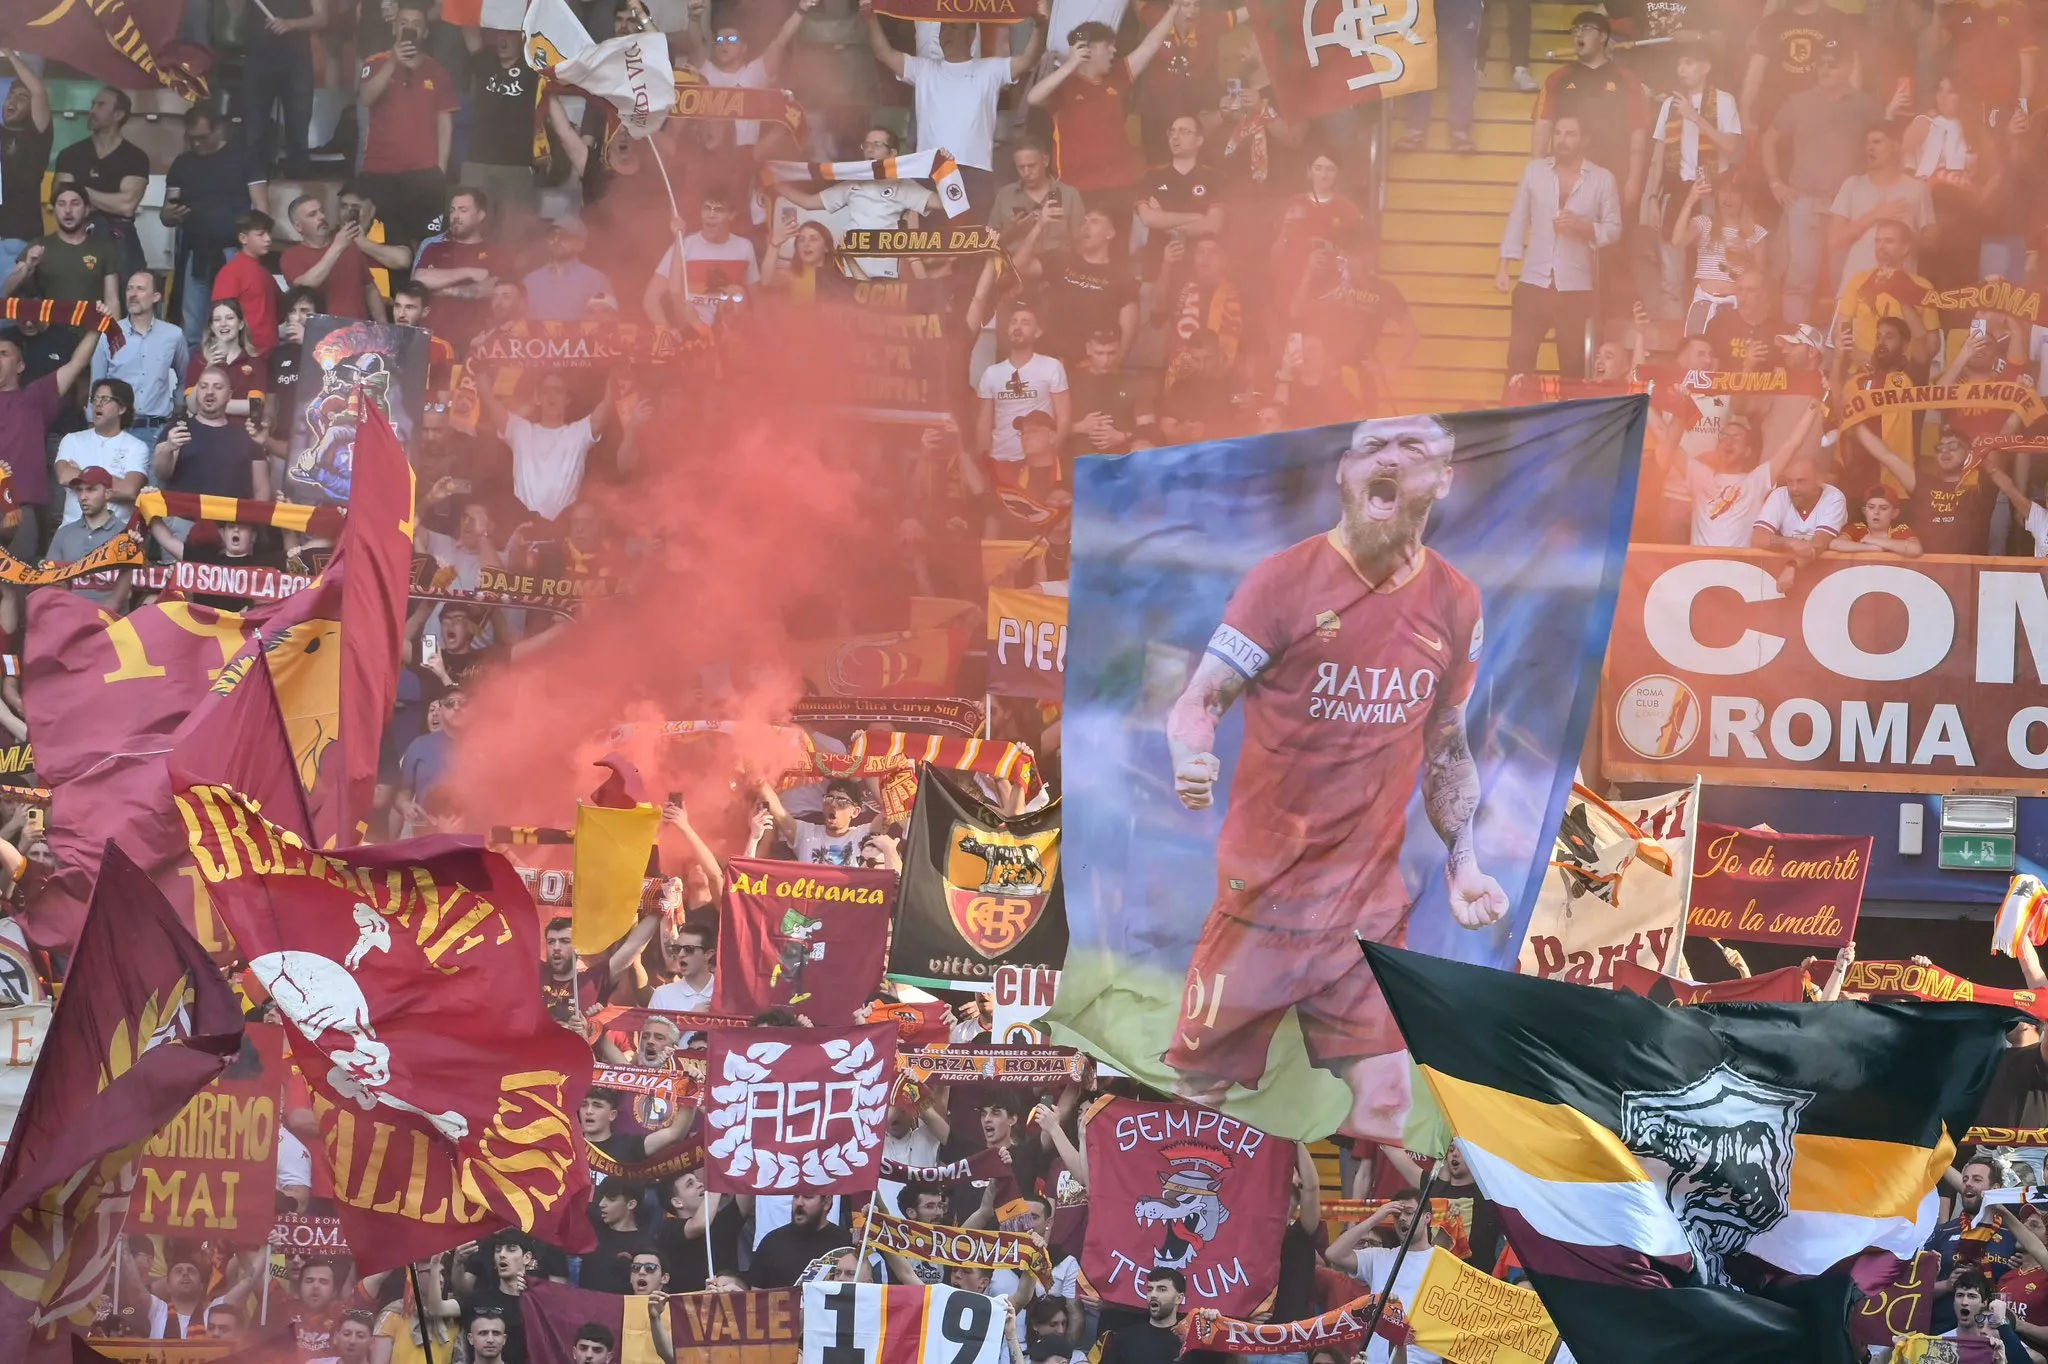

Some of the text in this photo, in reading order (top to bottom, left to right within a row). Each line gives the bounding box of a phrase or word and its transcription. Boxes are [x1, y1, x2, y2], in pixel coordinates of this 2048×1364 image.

[878, 231, 942, 250] ROMA
[1872, 386, 1960, 406] GRANDE
[1966, 385, 2035, 412] AMORE
[197, 565, 248, 593] SONO
[251, 568, 276, 598] LA
[479, 571, 534, 594] DAJE
[1636, 689, 1664, 697] ROMA
[934, 703, 959, 717] Sud
[1709, 695, 1976, 767] ROMA
[1748, 844, 1775, 876] di
[1781, 848, 1859, 881] amarti
[731, 872, 885, 905] Ad oltranza
[1686, 898, 1844, 937] non la smetto
[907, 1056, 977, 1073] FORZA
[1004, 1057, 1067, 1073] ROMA
[913, 1047, 969, 1056] FOREVER
[600, 1070, 673, 1091] ROMA
[939, 1073, 979, 1082] MAGICA
[1032, 1075, 1046, 1083] OK
[1115, 1108, 1265, 1160] SEMPER
[907, 1158, 972, 1182] ROMA
[139, 1167, 241, 1230] MAI
[930, 1230, 1020, 1265] ROMA
[1107, 1249, 1251, 1301] TEUM
[1452, 1263, 1544, 1324] FEDELE
[682, 1291, 792, 1342] VALE
[1228, 1309, 1364, 1346] ROMA
[1381, 1313, 1405, 1329] ROMA
[1422, 1285, 1553, 1361] COMPAGNA
[1228, 1330, 1364, 1352] CAPUT MUNDI
[1448, 1331, 1499, 1364] MIA
